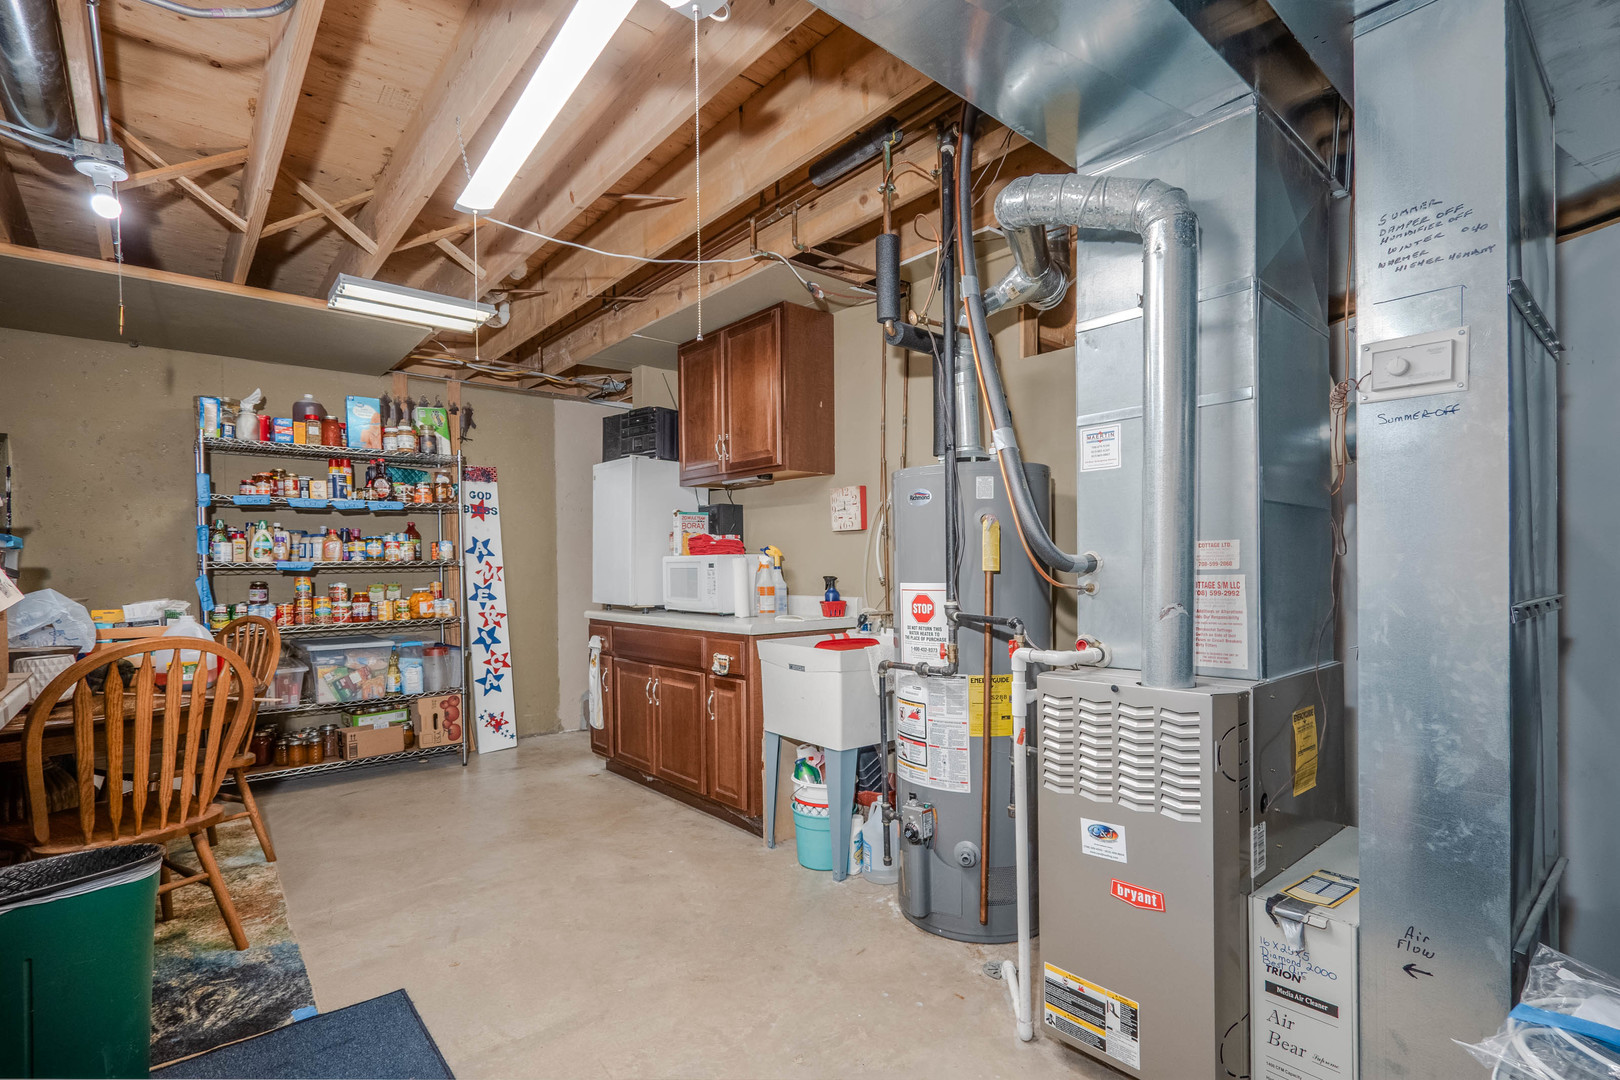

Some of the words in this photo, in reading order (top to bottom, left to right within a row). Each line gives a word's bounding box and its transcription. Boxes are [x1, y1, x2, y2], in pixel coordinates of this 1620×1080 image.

[1378, 198, 1443, 226] SUMMER
[1379, 216, 1430, 237] DAMPER
[1436, 203, 1464, 219] OFF
[1448, 208, 1473, 223] OFF
[1387, 232, 1445, 255] WINTER
[469, 490, 491, 500] GOD
[464, 505, 498, 515] BLESS
[681, 522, 705, 530] BORAX
[1230, 581, 1241, 589] LLC
[913, 603, 933, 615] STOP
[1117, 883, 1157, 907] bryant
[1404, 926, 1430, 942] Air
[1397, 939, 1435, 959] Flow
[1305, 962, 1338, 980] 2000
[1276, 986, 1294, 998] Media
[1294, 994, 1304, 1002] Air
[1305, 997, 1329, 1011] Cleaner
[1266, 1009, 1295, 1030] Air
[1267, 1029, 1307, 1058] Bear
